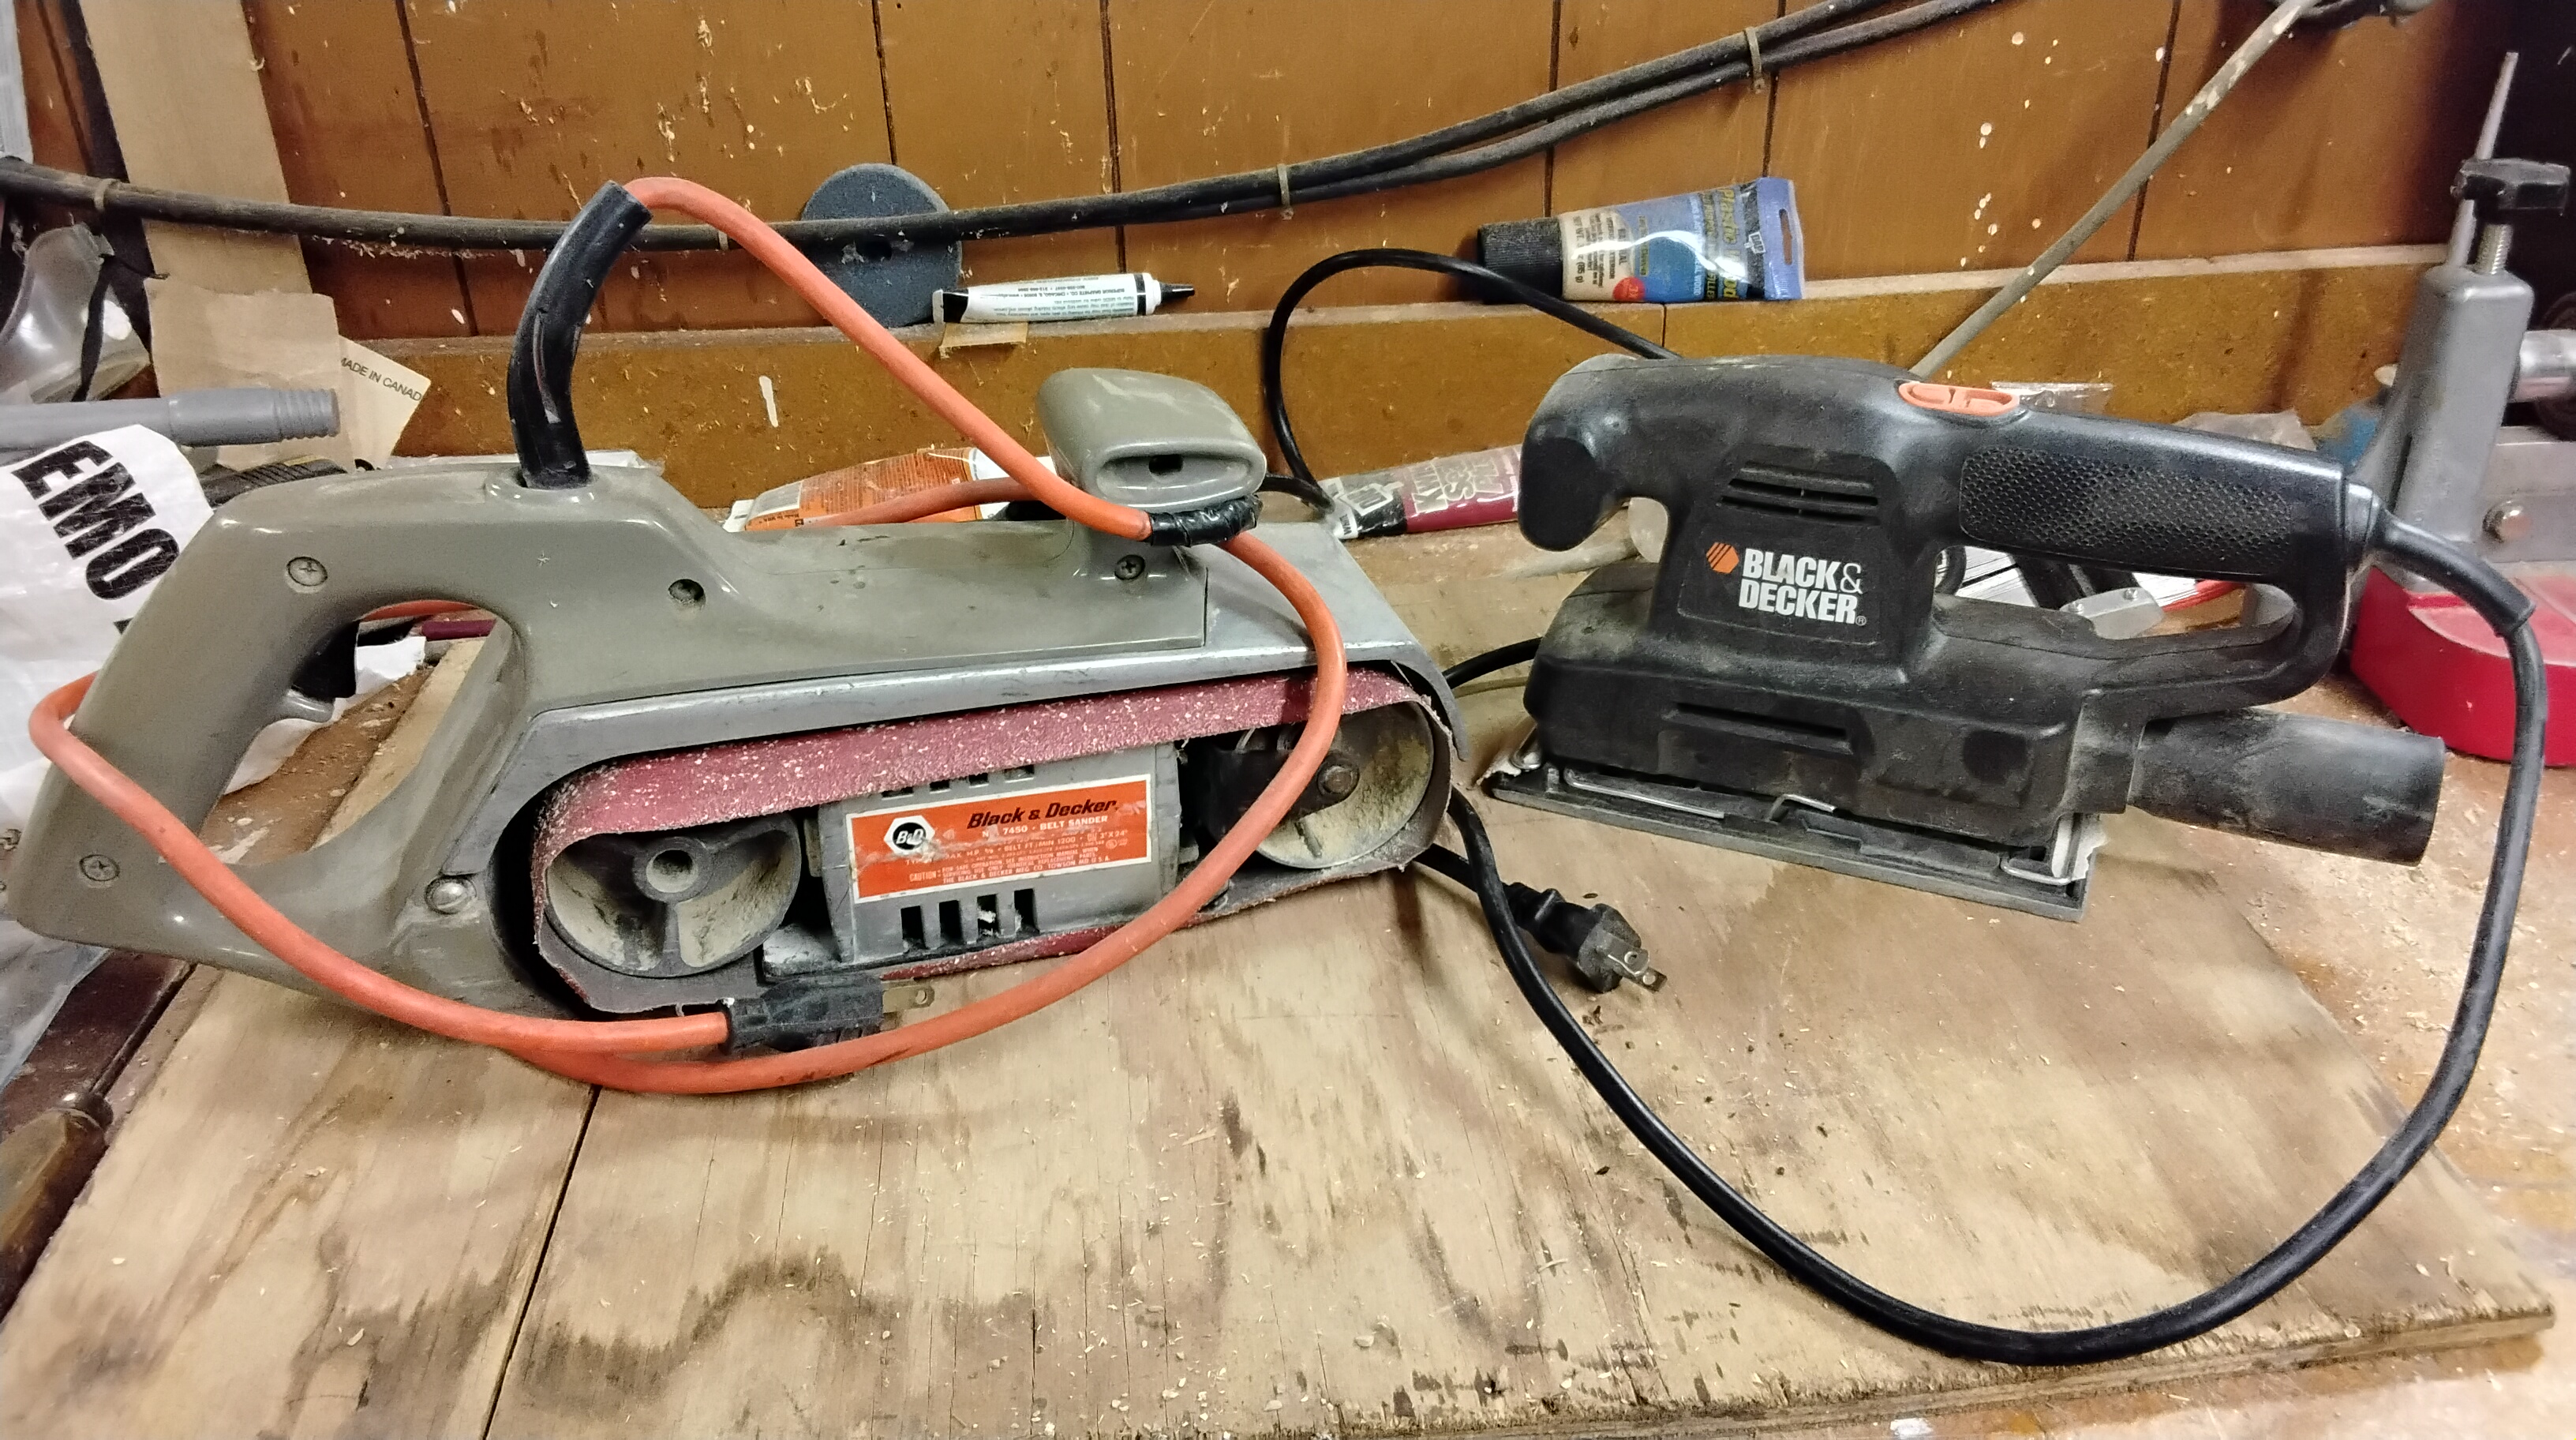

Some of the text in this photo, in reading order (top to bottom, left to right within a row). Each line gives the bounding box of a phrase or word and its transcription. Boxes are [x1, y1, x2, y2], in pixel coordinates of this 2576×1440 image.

[1706, 272, 1717, 300] FILLE
[1724, 249, 1741, 299] Wod
[340, 358, 369, 377] MADE
[368, 370, 382, 383] IN
[10, 441, 180, 634] EMO
[1739, 578, 1859, 624] DECKER
[967, 799, 1117, 830] Black & Decker
[1002, 825, 1028, 835] 7450
[1039, 820, 1065, 831] BELT
[1068, 815, 1109, 827] SANDER
